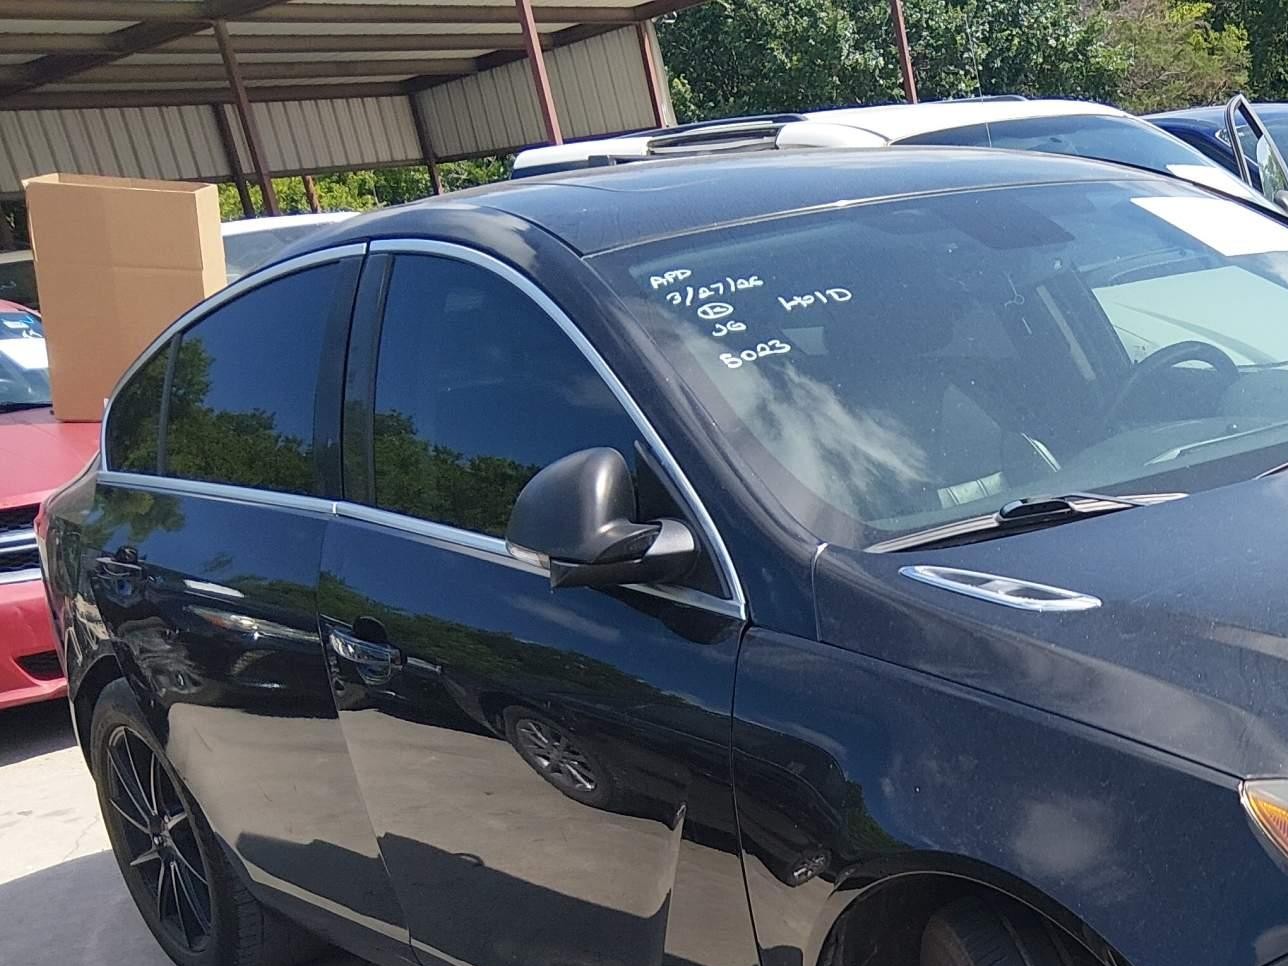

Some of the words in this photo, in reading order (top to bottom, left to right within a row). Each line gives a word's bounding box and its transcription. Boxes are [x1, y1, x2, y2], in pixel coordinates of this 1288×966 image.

[649, 268, 692, 289] APD
[666, 275, 764, 306] 3/27/26
[719, 339, 792, 369] 5023
